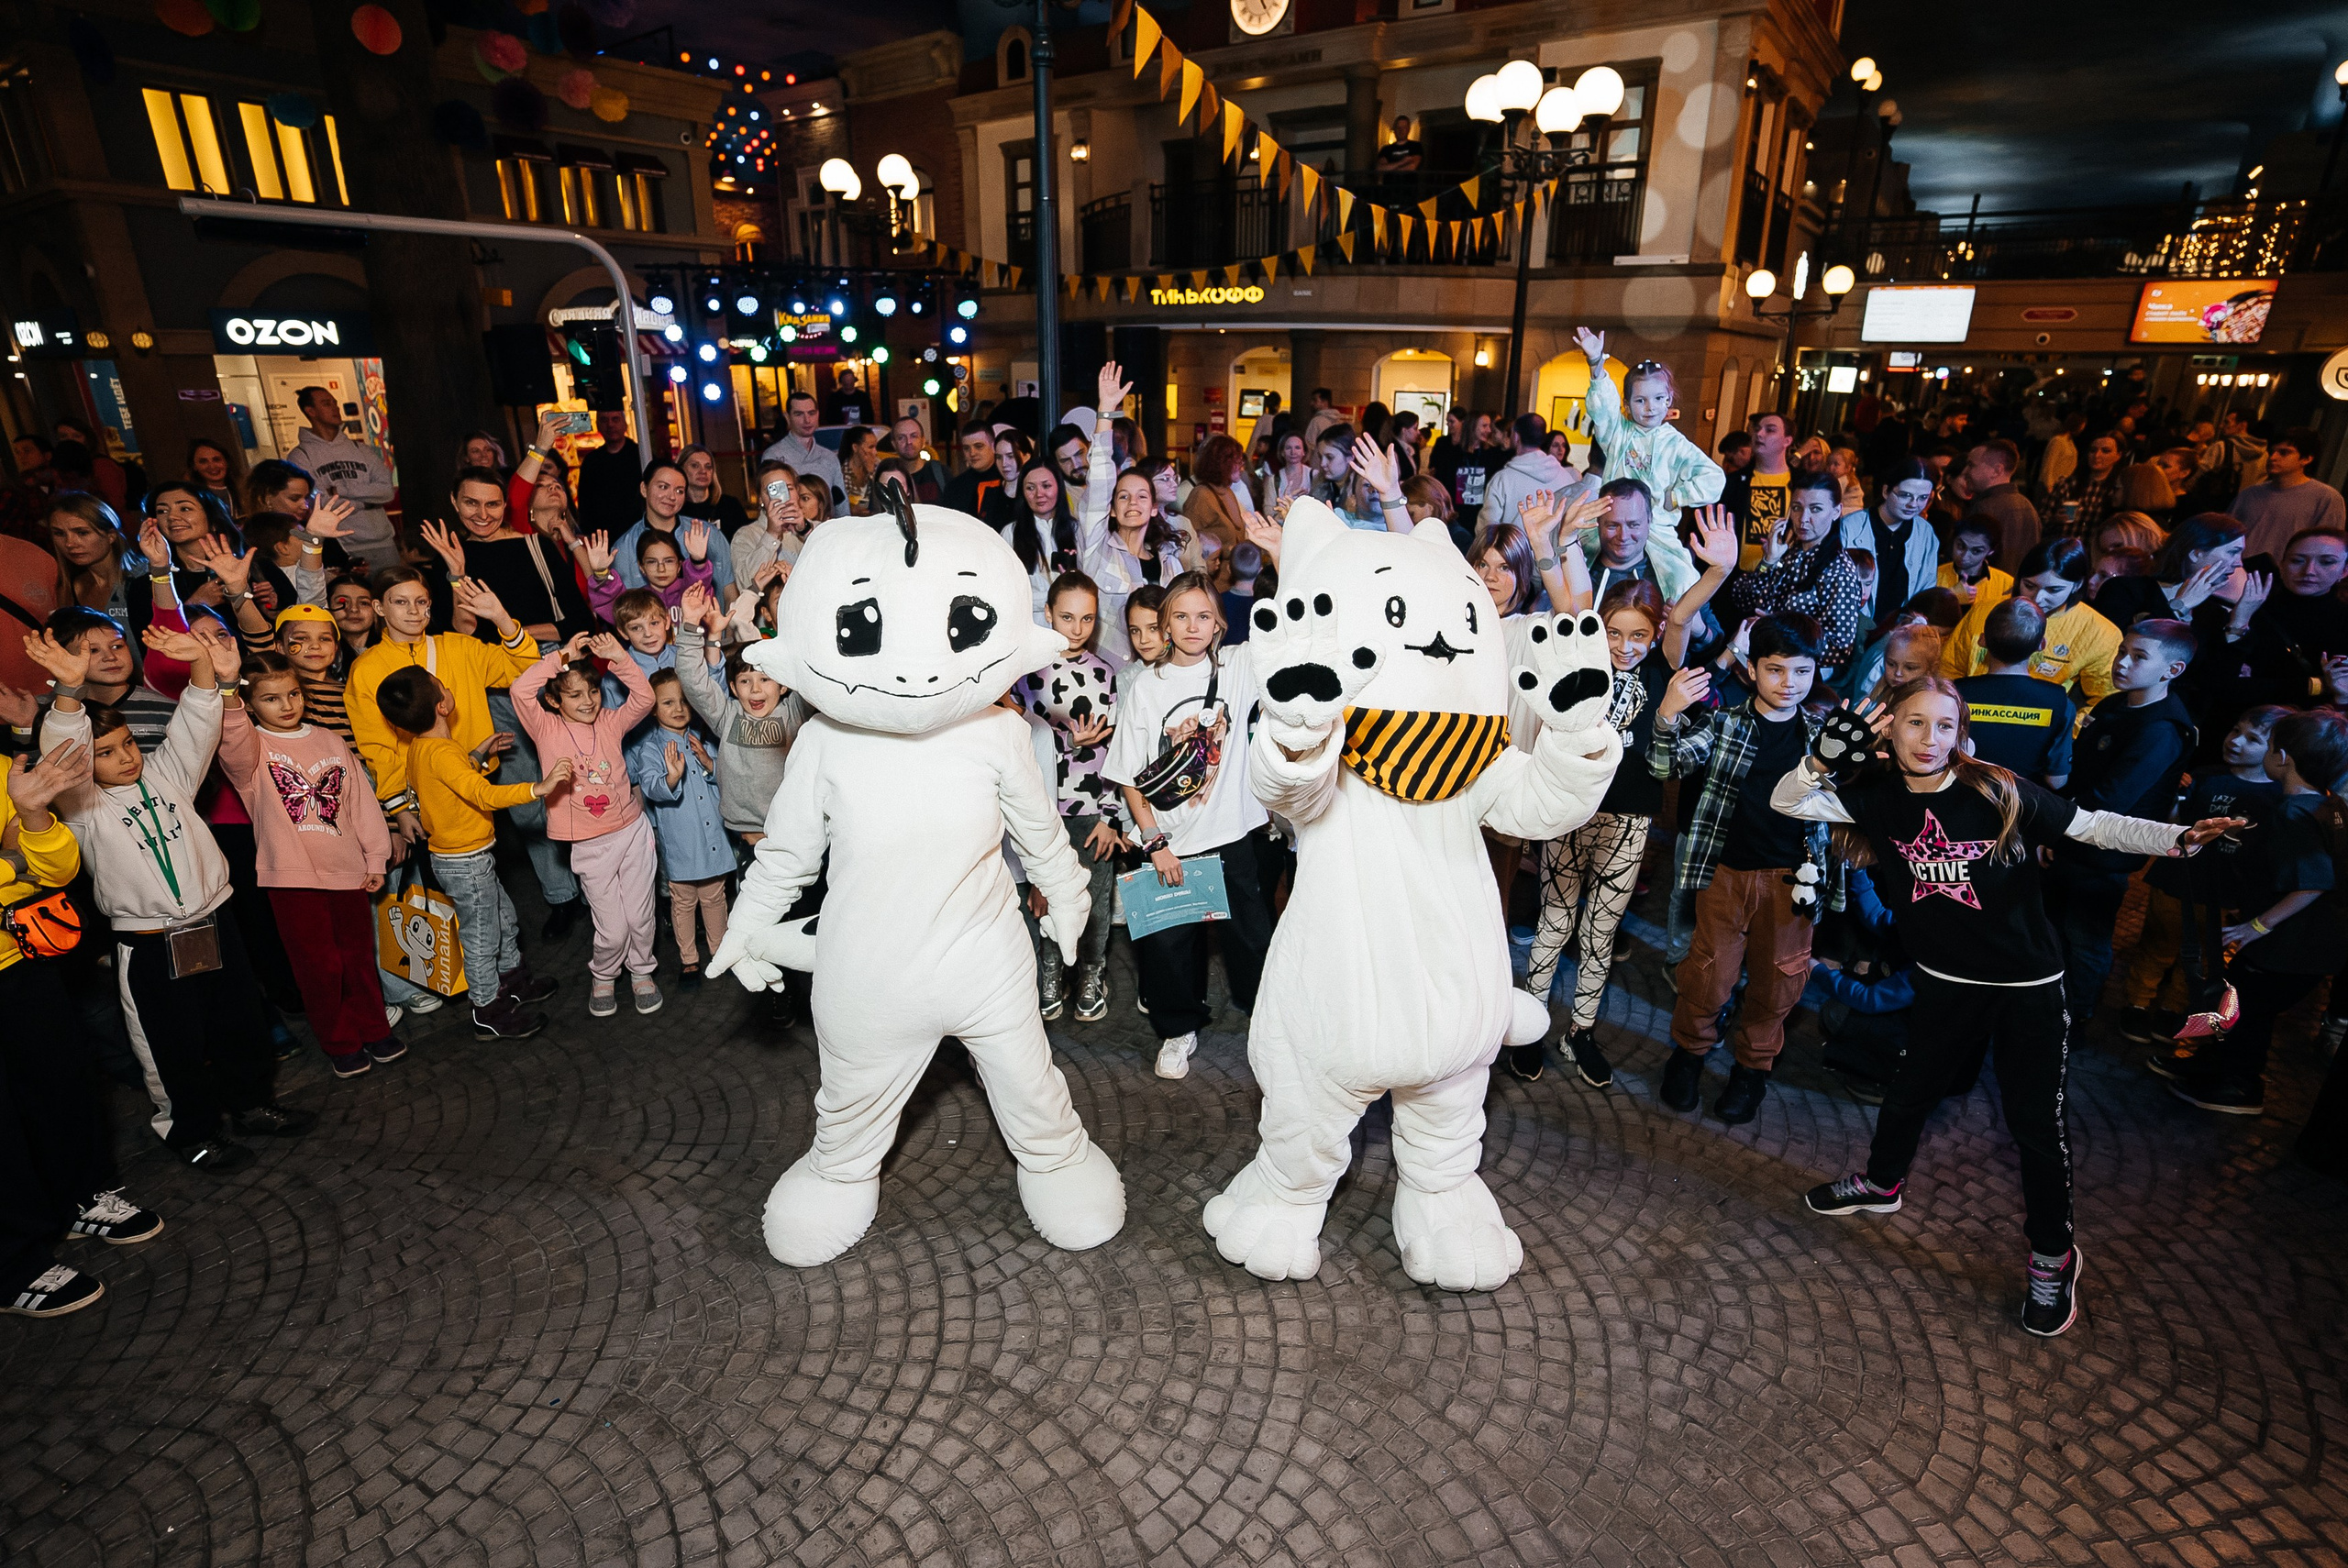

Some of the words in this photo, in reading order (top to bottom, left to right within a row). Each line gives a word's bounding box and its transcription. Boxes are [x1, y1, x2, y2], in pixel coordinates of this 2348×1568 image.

[15, 321, 44, 347] OZON
[226, 317, 340, 346] OZON
[1610, 708, 1623, 728] OVE
[1970, 708, 2041, 721] ИНКАССАЦИЯ
[320, 756, 341, 768] MAGIC
[297, 825, 325, 834] AROUND
[437, 918, 450, 996] билайн
